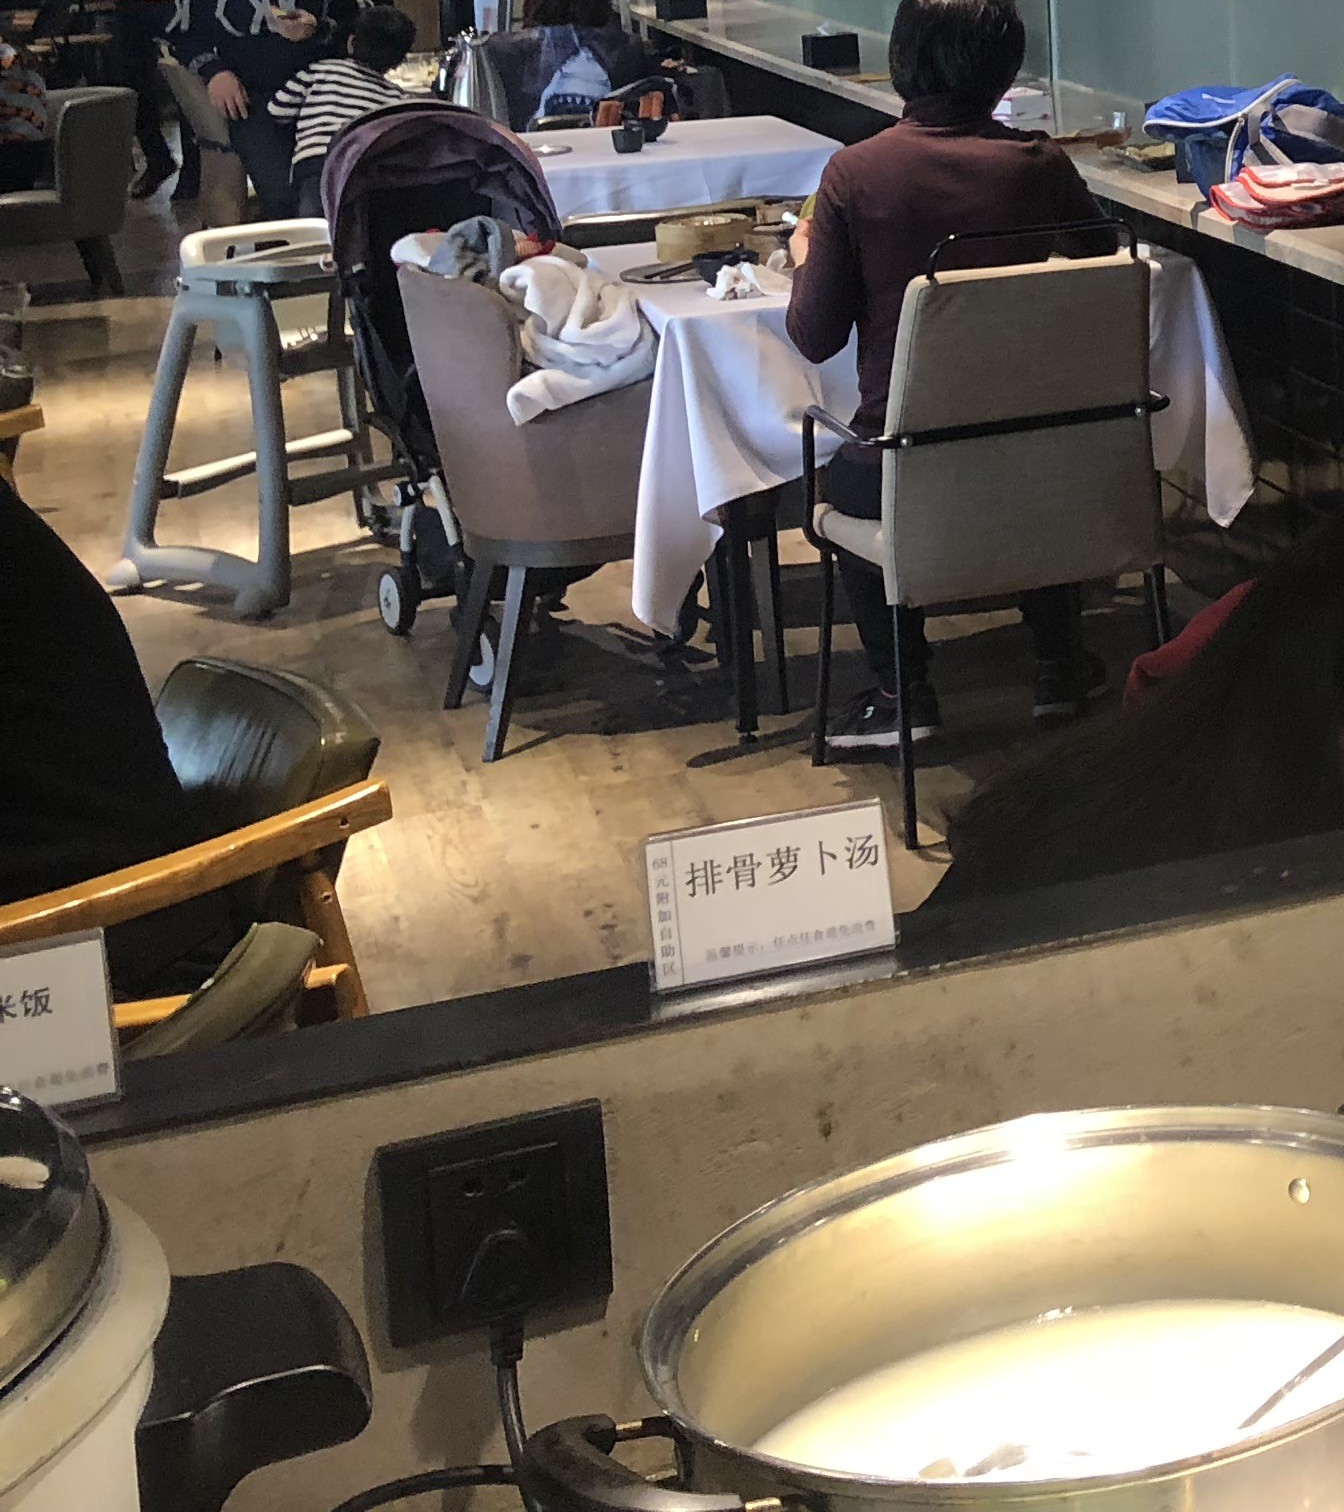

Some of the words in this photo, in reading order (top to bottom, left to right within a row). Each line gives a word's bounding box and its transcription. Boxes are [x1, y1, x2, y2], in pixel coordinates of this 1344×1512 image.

[684, 833, 880, 899] 排骨萝卜汤
